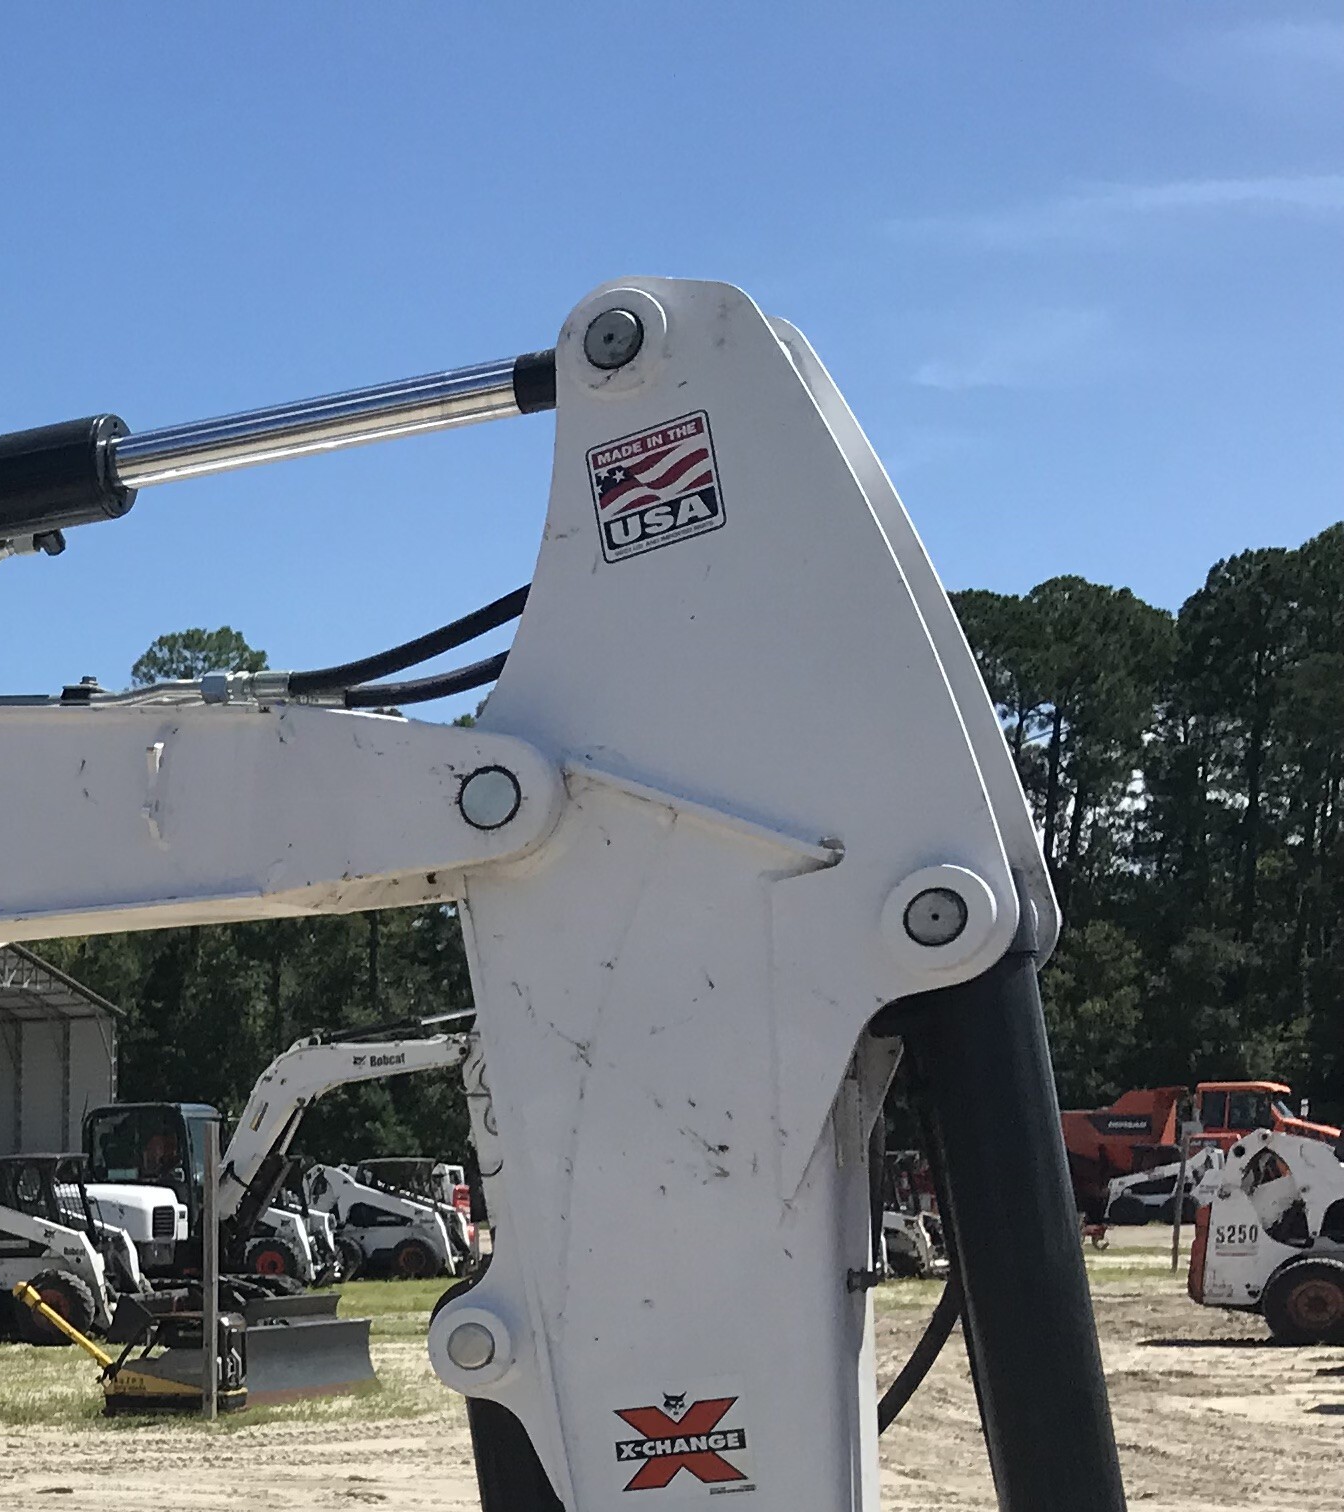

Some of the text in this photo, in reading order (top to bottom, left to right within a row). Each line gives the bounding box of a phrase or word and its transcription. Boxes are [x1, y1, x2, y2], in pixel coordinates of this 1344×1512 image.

[597, 421, 697, 466] MADE IN THE
[610, 494, 713, 545] USA
[369, 1052, 406, 1067] Bobcat
[1215, 1224, 1258, 1244] S250
[620, 1432, 740, 1459] X-CHANGE
